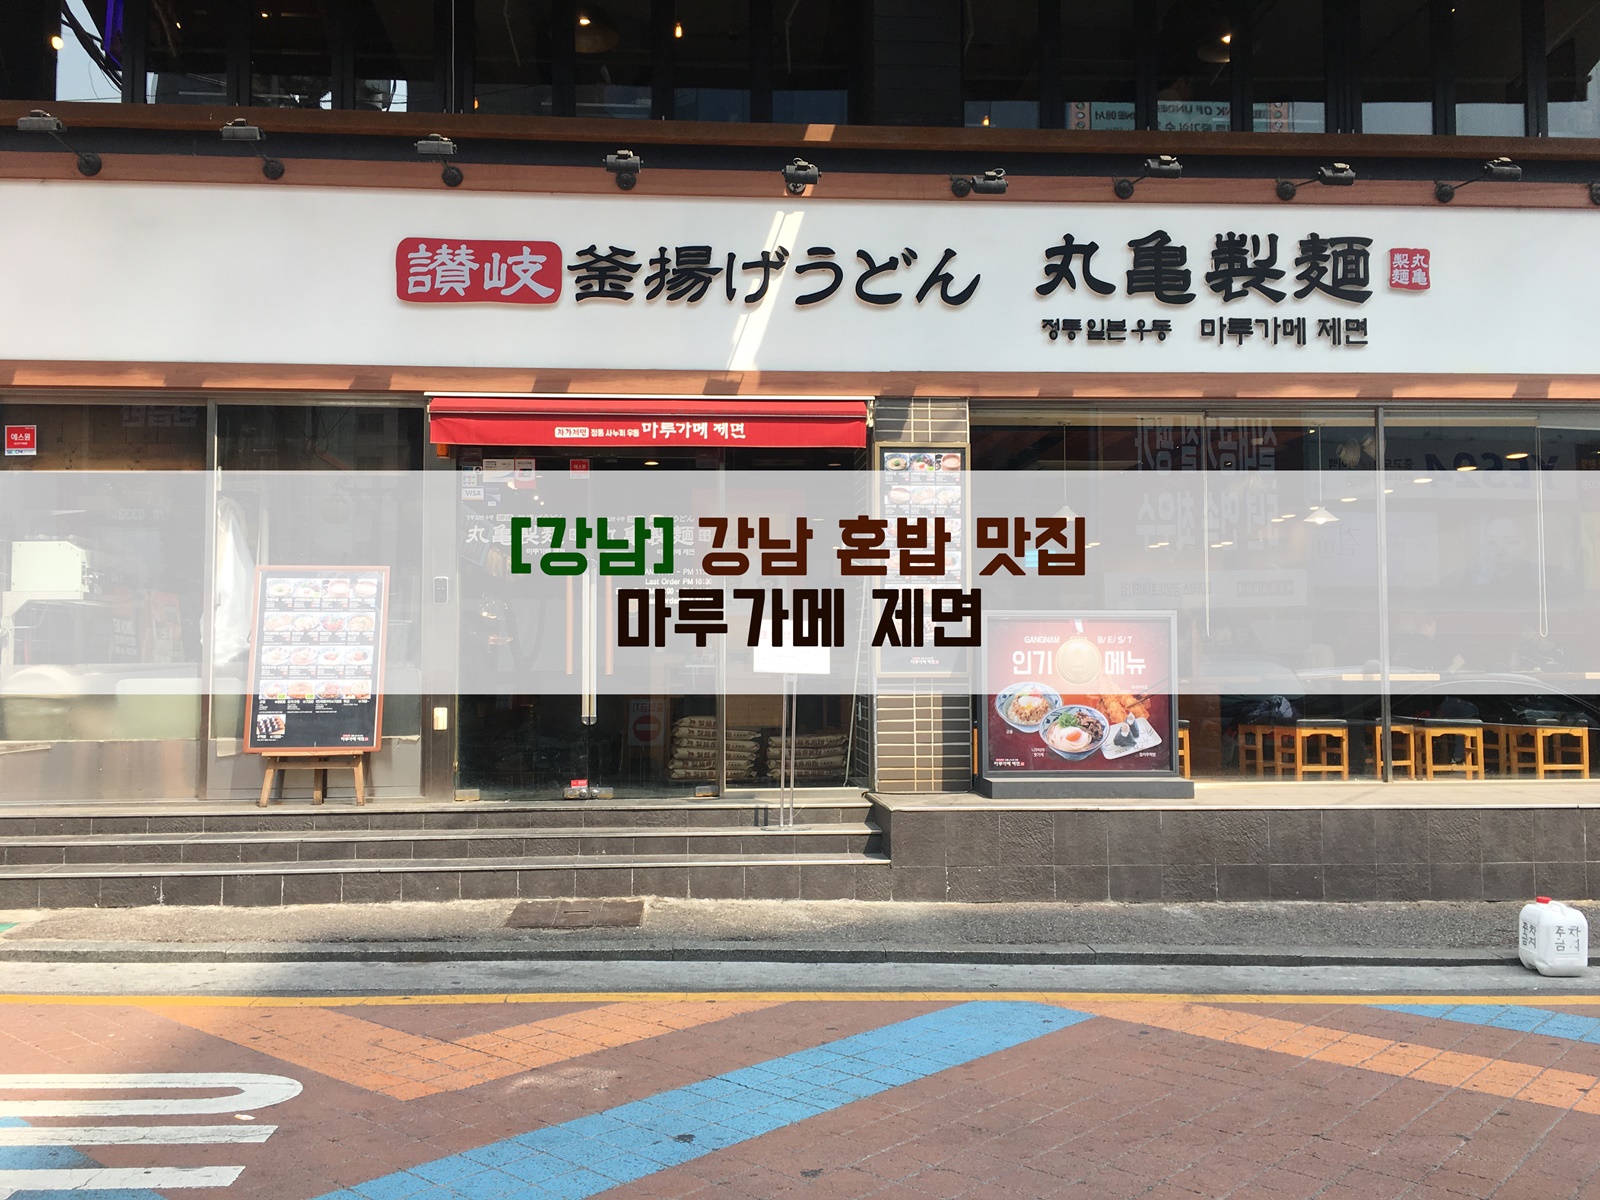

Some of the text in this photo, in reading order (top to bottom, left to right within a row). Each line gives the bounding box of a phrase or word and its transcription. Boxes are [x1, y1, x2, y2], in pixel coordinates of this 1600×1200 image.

[408, 244, 980, 306] 讃岐 釜揚げうどん
[1036, 230, 1373, 304] 丸亀製麺
[1200, 317, 1306, 345] 마루가메
[1317, 318, 1368, 345] 제면
[10, 432, 31, 442] 에스원
[641, 422, 708, 439] 마루가메
[713, 422, 746, 439] 제면
[465, 489, 482, 497] VISA
[1024, 635, 1061, 644] GANGNAM
[1012, 650, 1147, 675] 인기 메뉴
[1555, 925, 1582, 938] 주차
